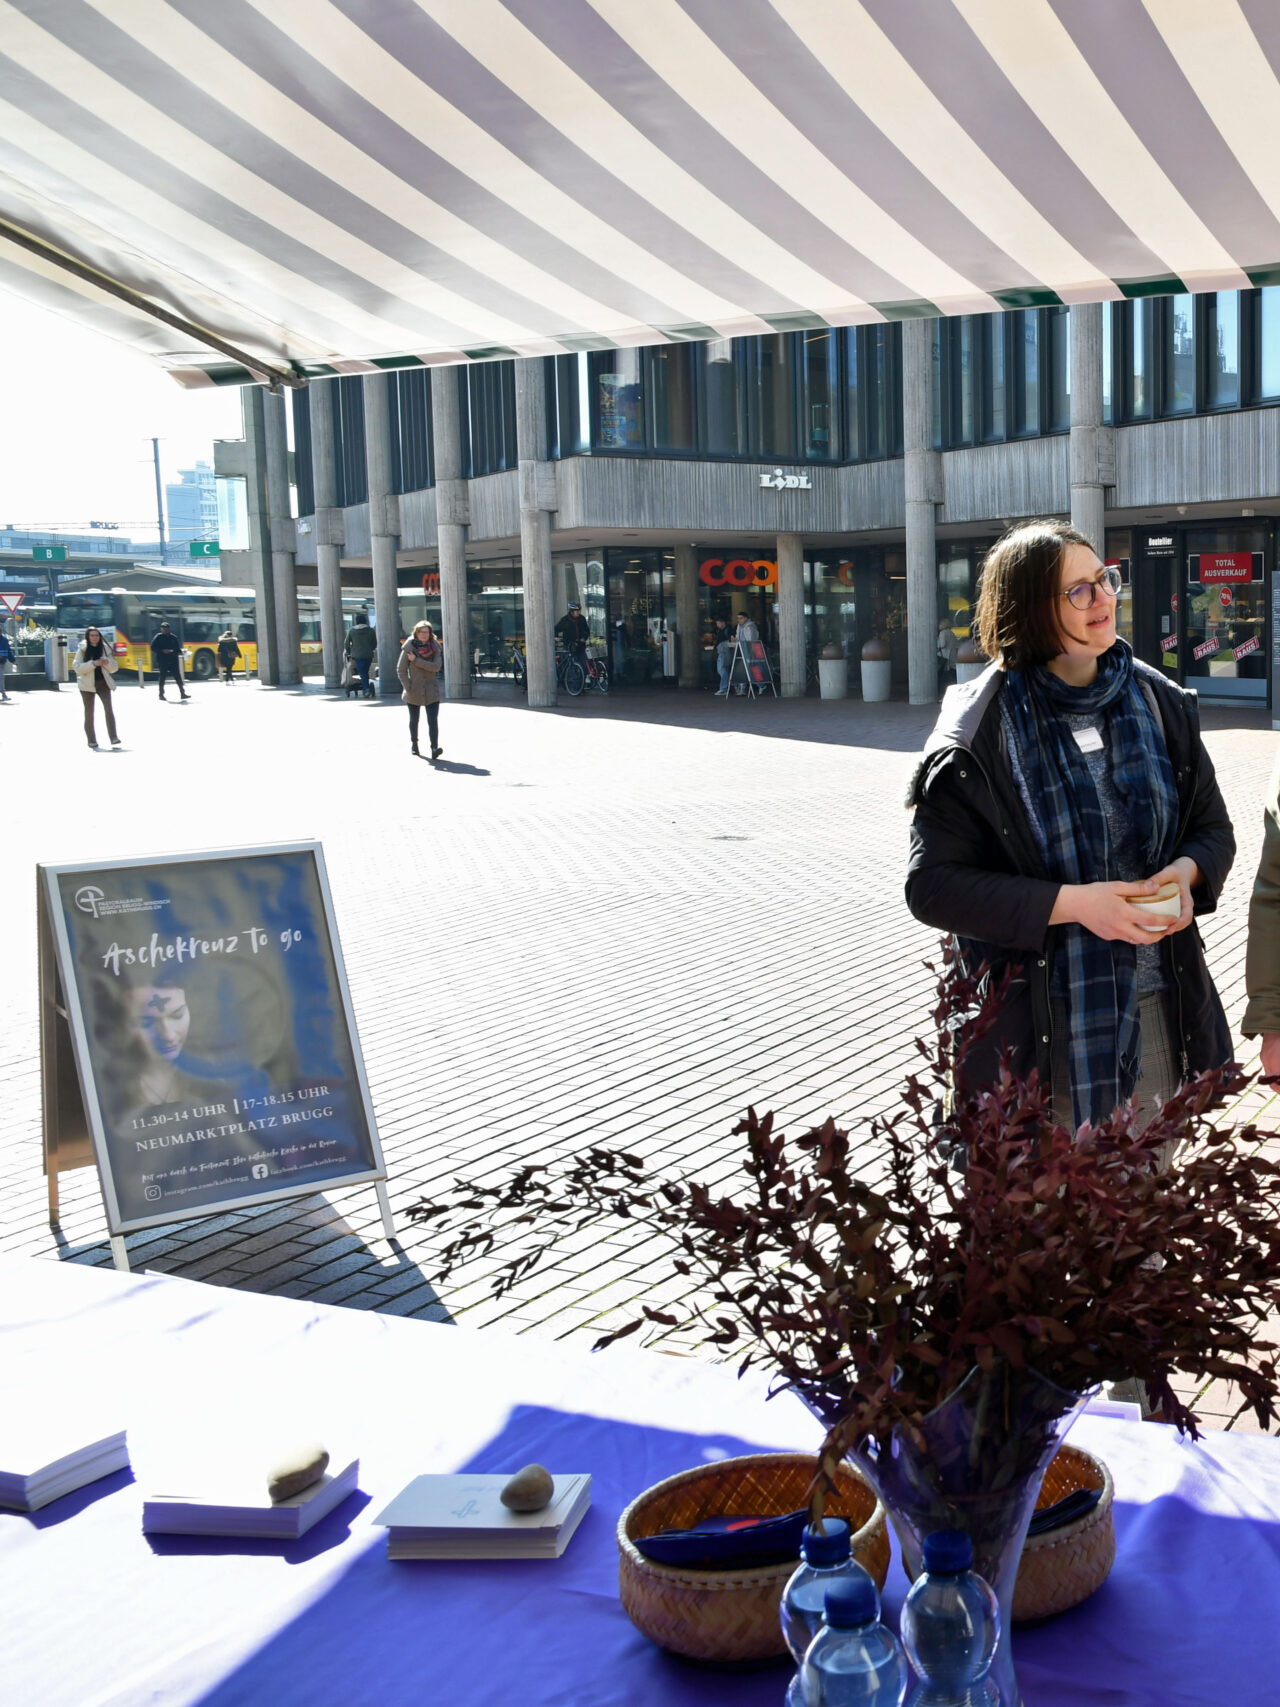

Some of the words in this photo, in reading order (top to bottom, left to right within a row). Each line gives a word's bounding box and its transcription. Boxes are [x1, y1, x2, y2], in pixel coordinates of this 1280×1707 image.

[46, 549, 53, 559] B
[203, 544, 210, 554] C
[1215, 559, 1236, 567] TOTAL
[699, 558, 778, 594] coo
[1204, 568, 1247, 577] AUSVERKAUF
[1164, 638, 1178, 650] RAU
[1197, 643, 1216, 658] RAUS
[1236, 643, 1256, 658] RAUS
[101, 932, 239, 976] Aschekreuz
[280, 928, 302, 951] go
[193, 1103, 228, 1118] UHR
[297, 1085, 330, 1100] UHR
[135, 1117, 278, 1152] NEUMARKTPLATZ
[282, 1106, 334, 1125] BRUGG
